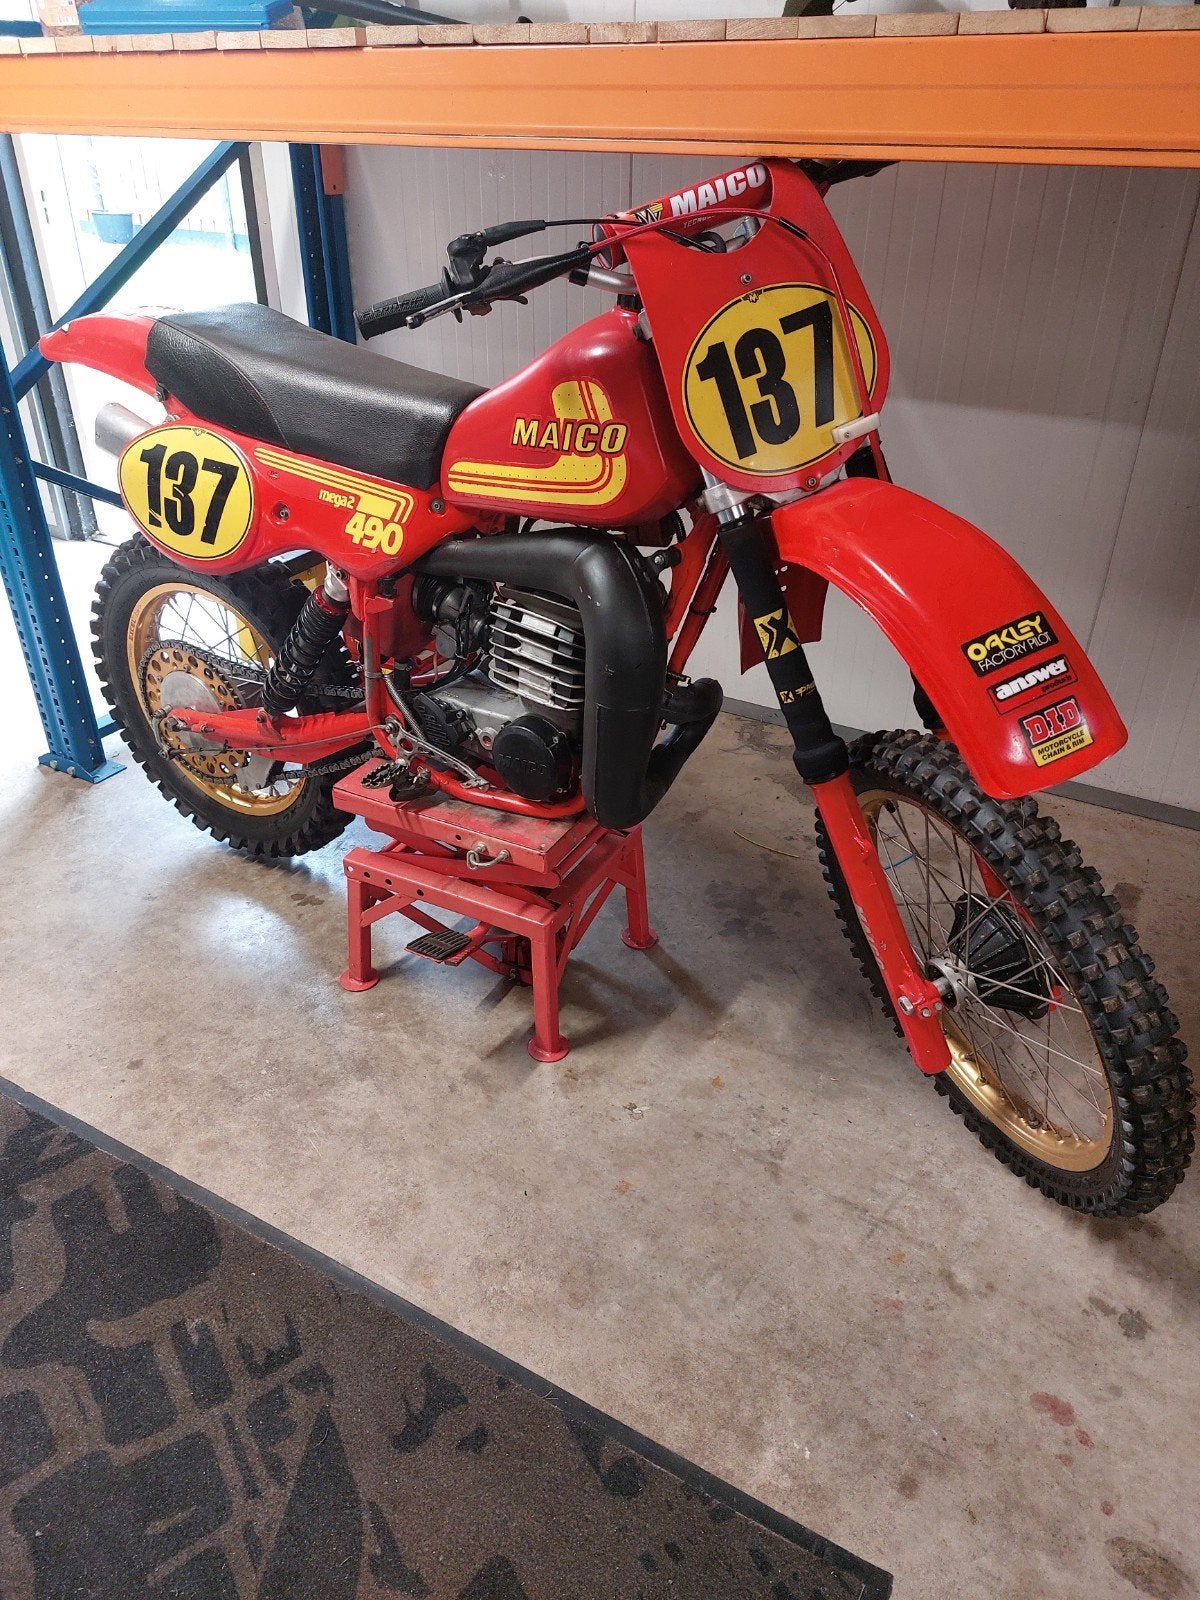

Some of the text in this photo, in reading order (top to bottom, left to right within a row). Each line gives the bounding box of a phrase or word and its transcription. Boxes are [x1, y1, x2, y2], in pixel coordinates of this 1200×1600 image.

[669, 164, 767, 217] MAICO
[696, 300, 834, 460] 137
[512, 418, 628, 454] MAICO
[140, 443, 240, 545] 137
[345, 511, 404, 555] 490
[967, 615, 1041, 661] OAKLEY
[978, 631, 1052, 672] FACTORY PILOT
[995, 659, 1068, 700] answer
[1037, 729, 1085, 755] MOTORCYCLE
[1042, 746, 1066, 761] CHAIN
[1072, 737, 1085, 748] RIM
